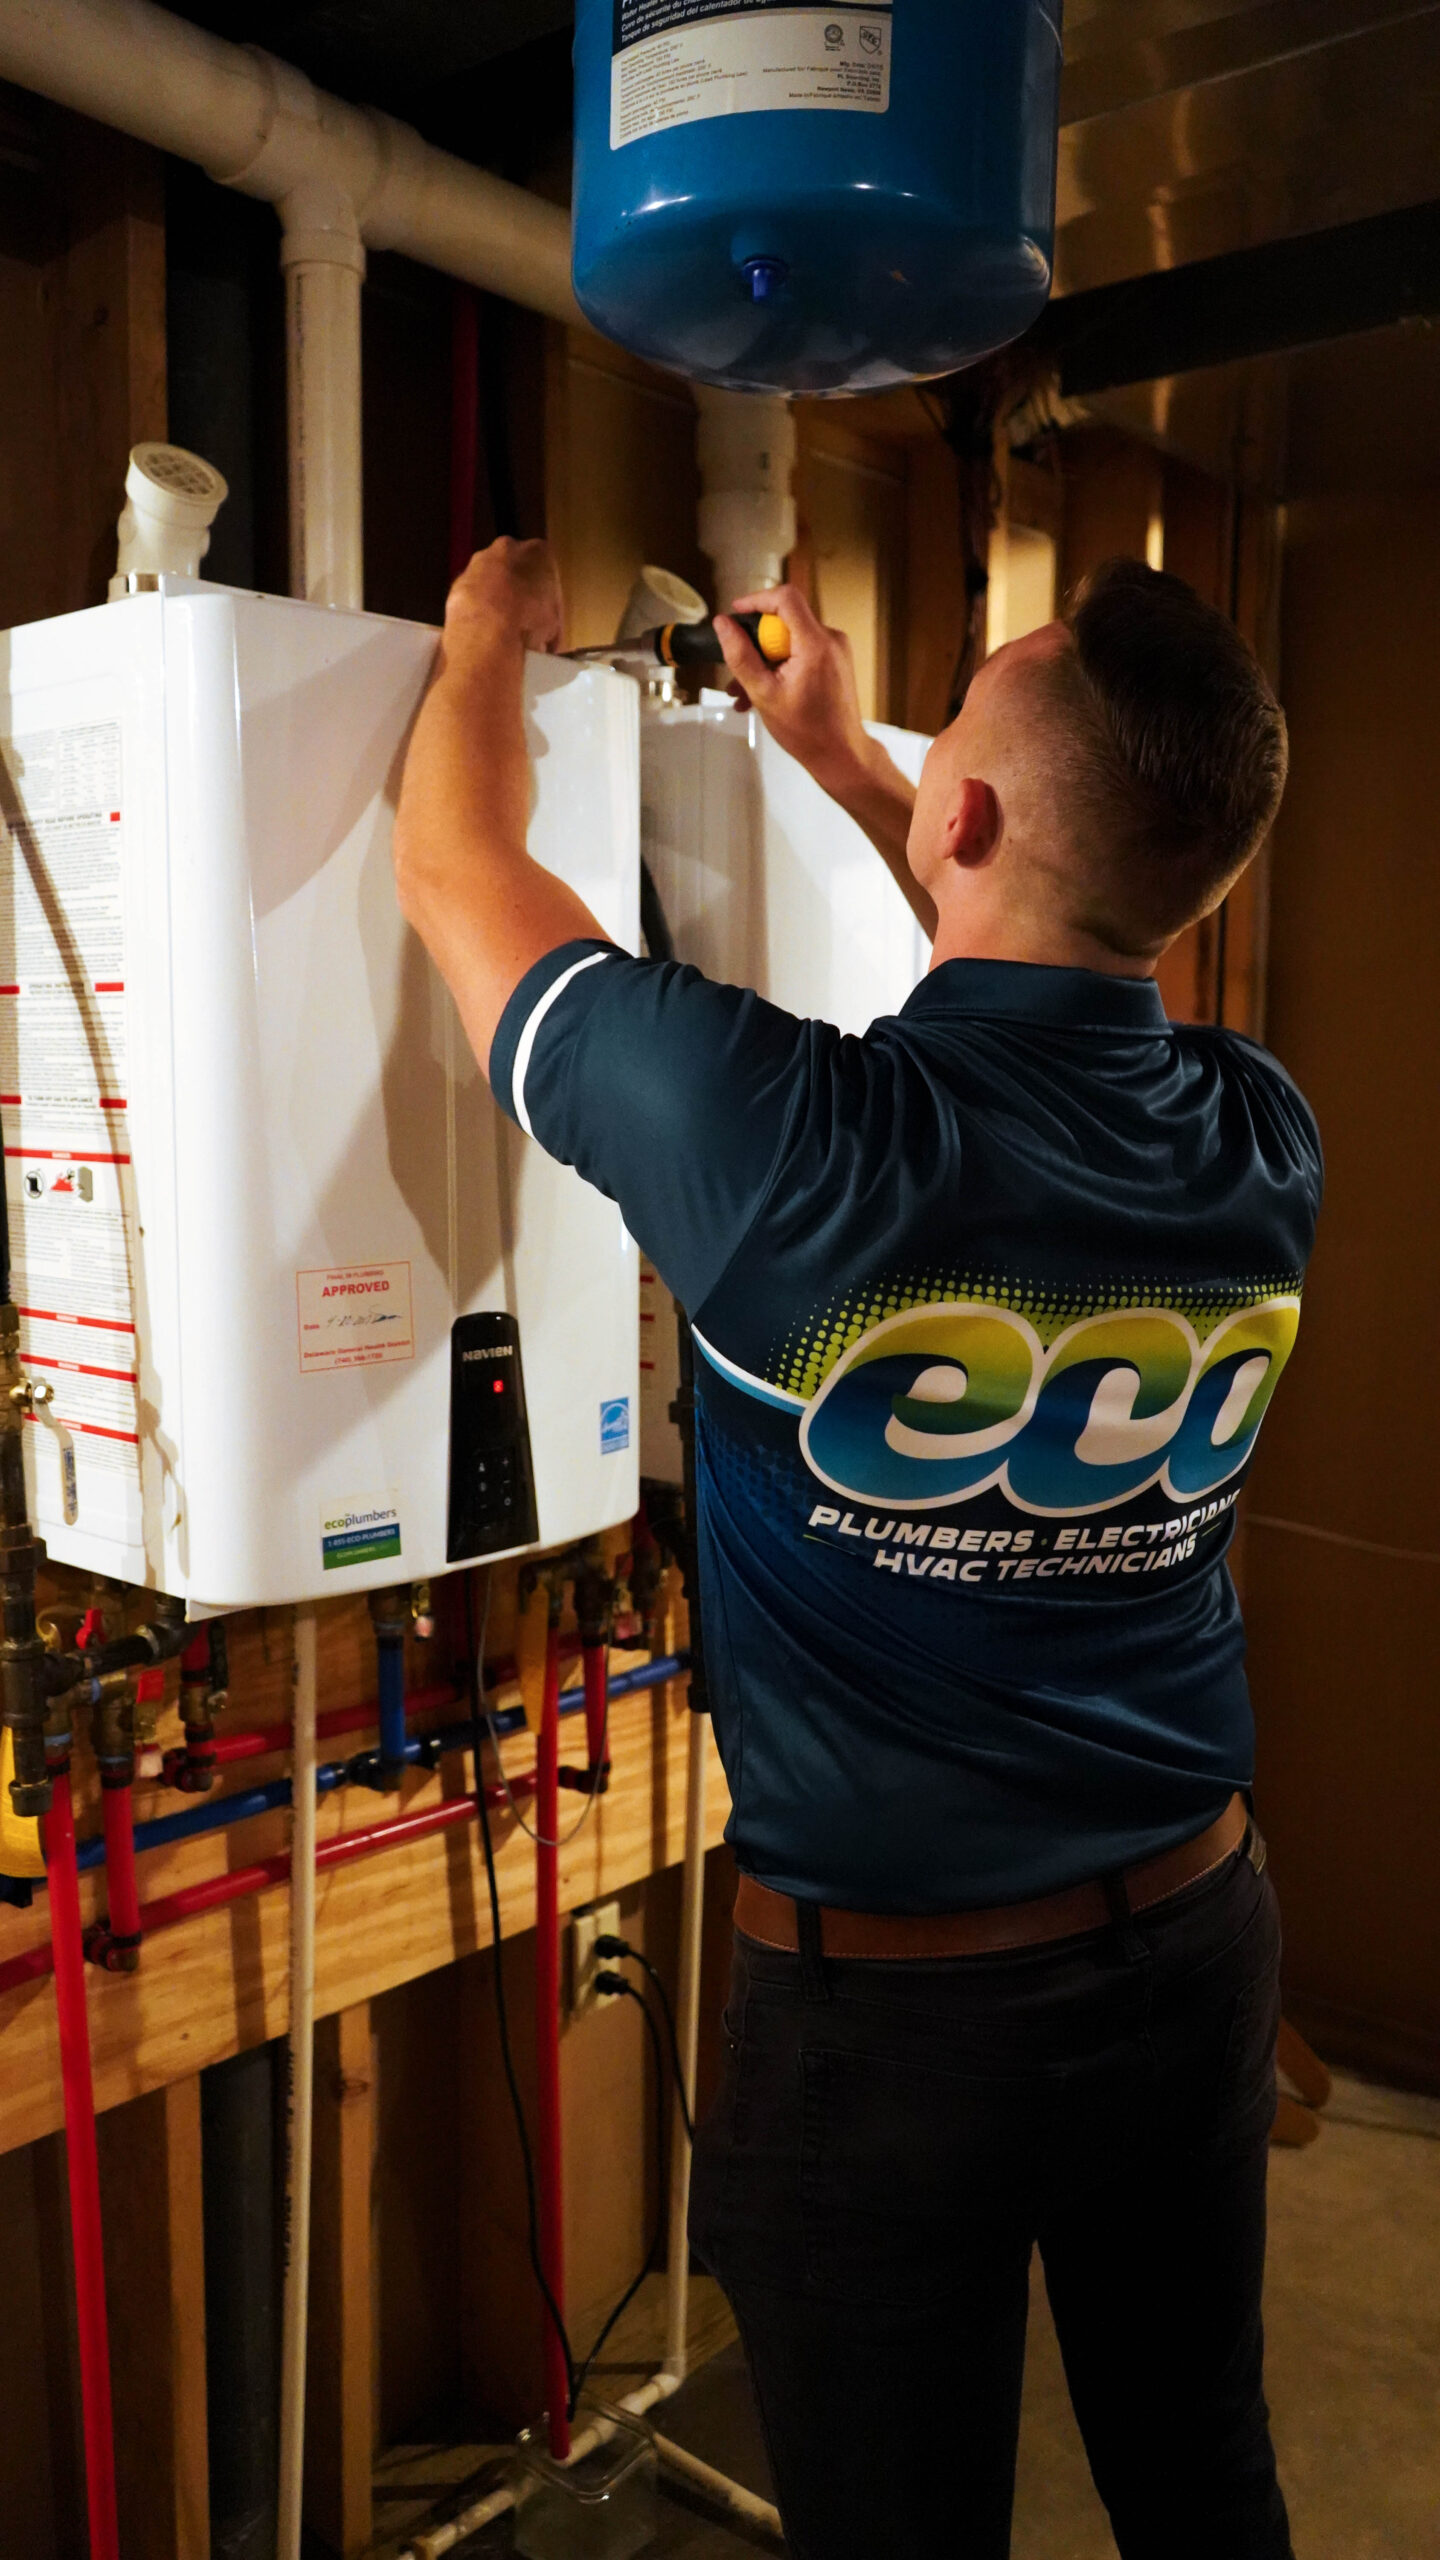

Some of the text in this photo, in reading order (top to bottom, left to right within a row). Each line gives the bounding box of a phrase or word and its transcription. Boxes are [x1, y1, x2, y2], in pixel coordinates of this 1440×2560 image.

[651, 9, 686, 29] seguridad
[686, 5, 699, 16] del
[321, 1280, 390, 1298] APPROVED
[799, 1295, 1301, 1518] eco
[324, 1508, 397, 1530] ecoplumbers
[807, 1504, 1035, 1553] PLUMBERS
[873, 1532, 1197, 1583] HVAC TECHNICIANS
